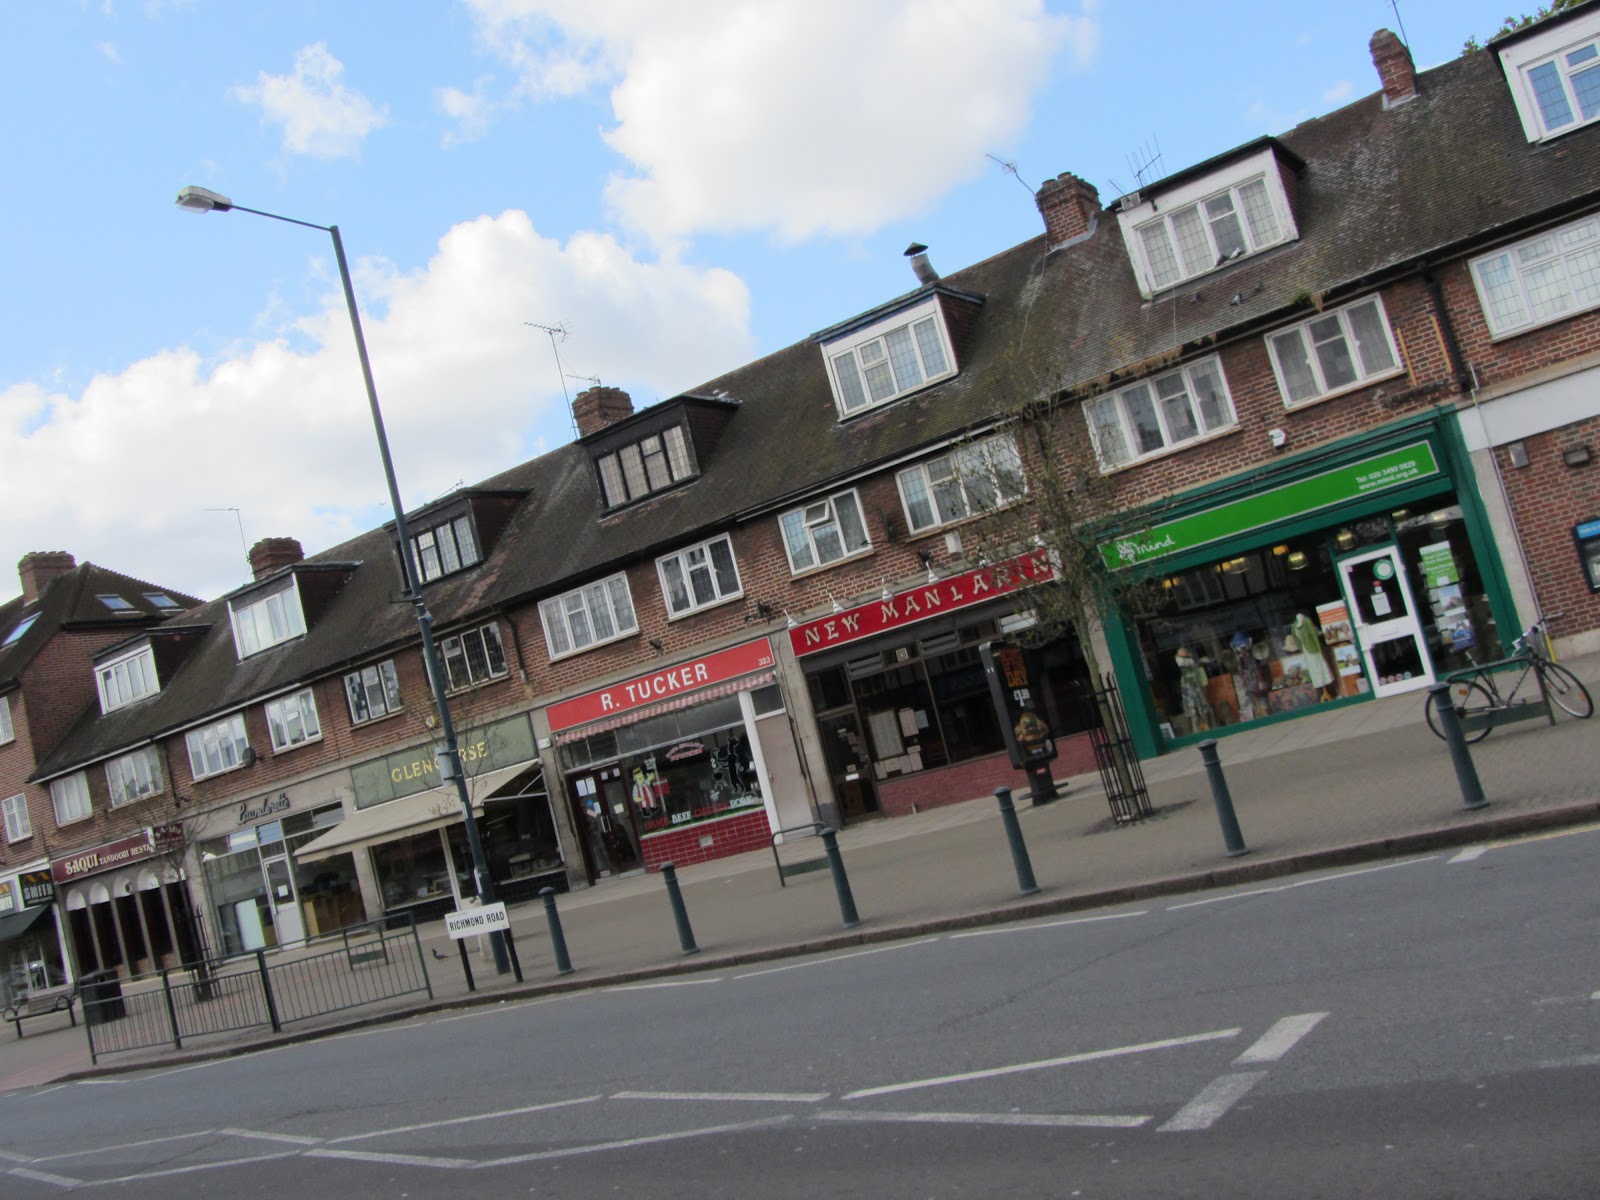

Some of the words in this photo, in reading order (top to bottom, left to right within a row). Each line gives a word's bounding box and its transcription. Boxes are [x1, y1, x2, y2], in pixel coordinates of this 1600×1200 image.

[1135, 533, 1176, 555] mind
[804, 613, 860, 646] NEW
[758, 656, 771, 666] 323
[600, 693, 620, 711] R.
[625, 663, 708, 702] TUCKER
[391, 742, 488, 783] GLENRSE
[671, 810, 691, 824] BEEF
[64, 852, 99, 875] SAQUI
[99, 849, 130, 866] TANDOORI
[23, 882, 53, 900] SMITH
[449, 915, 484, 931] RICHMOND
[486, 911, 505, 923] ROAD
